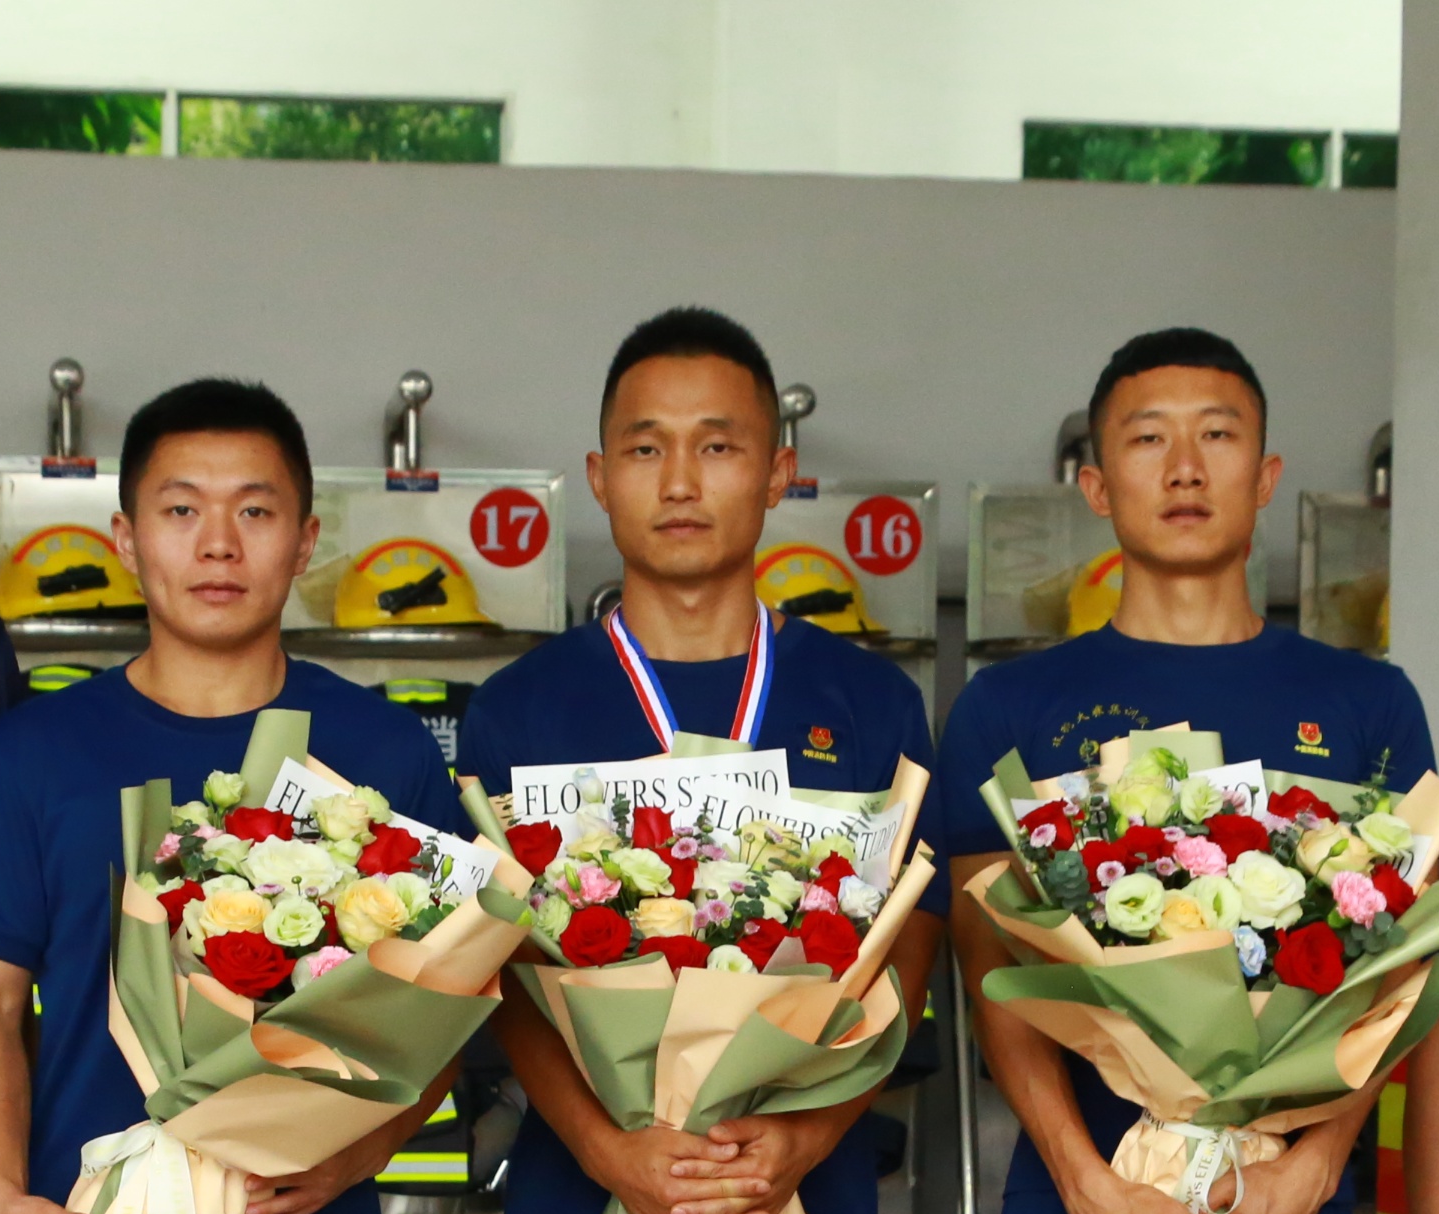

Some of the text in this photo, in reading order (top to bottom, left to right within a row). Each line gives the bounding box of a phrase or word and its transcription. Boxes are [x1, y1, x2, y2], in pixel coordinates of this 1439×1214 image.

[479, 505, 541, 552] 17
[854, 513, 913, 559] 16
[523, 778, 667, 816] FLOERS
